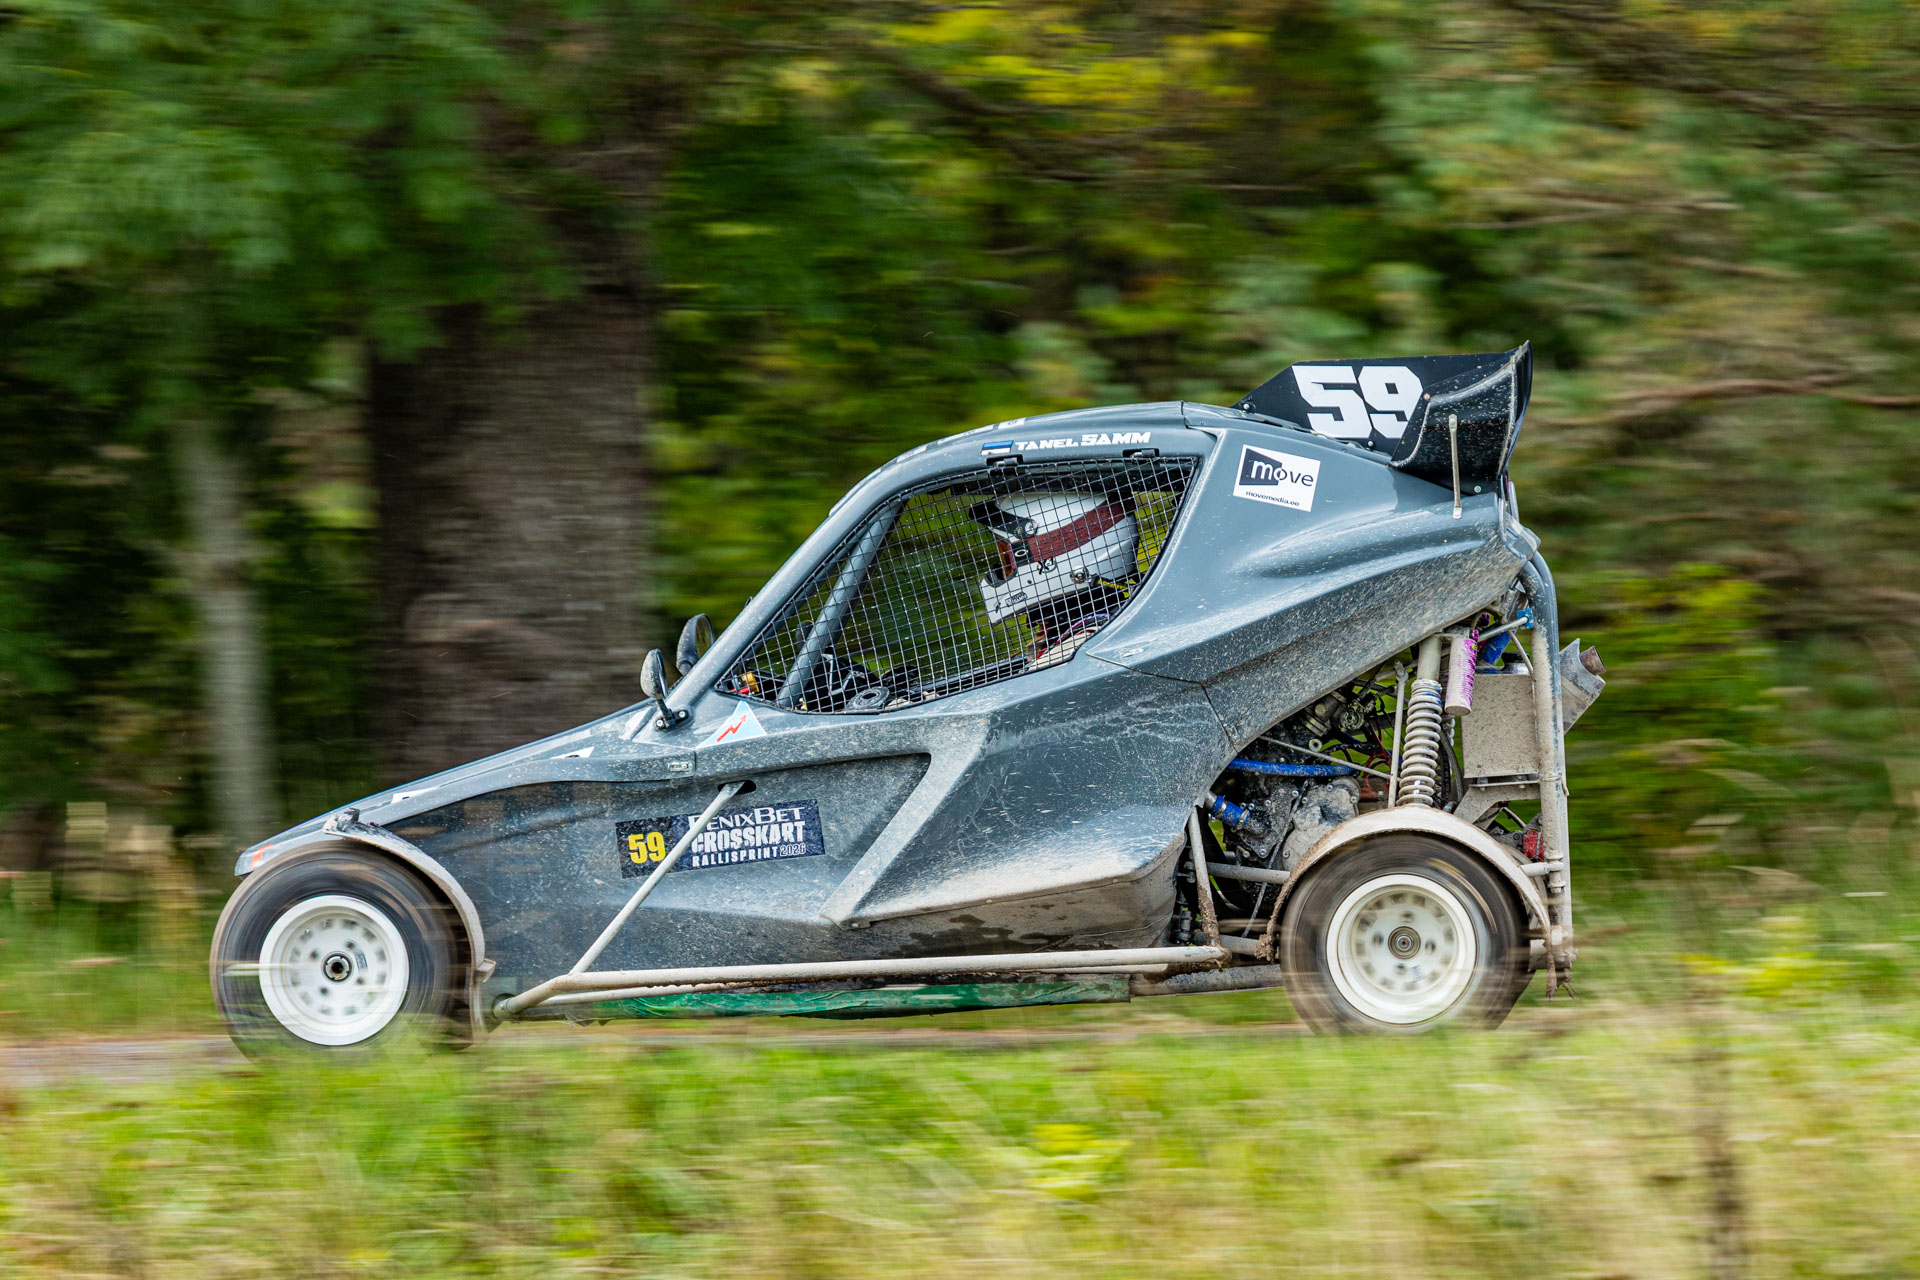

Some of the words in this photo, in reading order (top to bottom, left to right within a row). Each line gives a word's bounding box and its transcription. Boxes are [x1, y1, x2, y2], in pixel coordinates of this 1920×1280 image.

[1292, 365, 1424, 439] 59
[1015, 438, 1079, 451] TANEL
[1081, 431, 1152, 446] SAMM
[1250, 460, 1314, 487] move
[1245, 491, 1300, 506] movemedia.ee
[628, 831, 668, 864] 59
[691, 820, 806, 854] CROSSKART
[692, 846, 778, 868] RALLISPRINT
